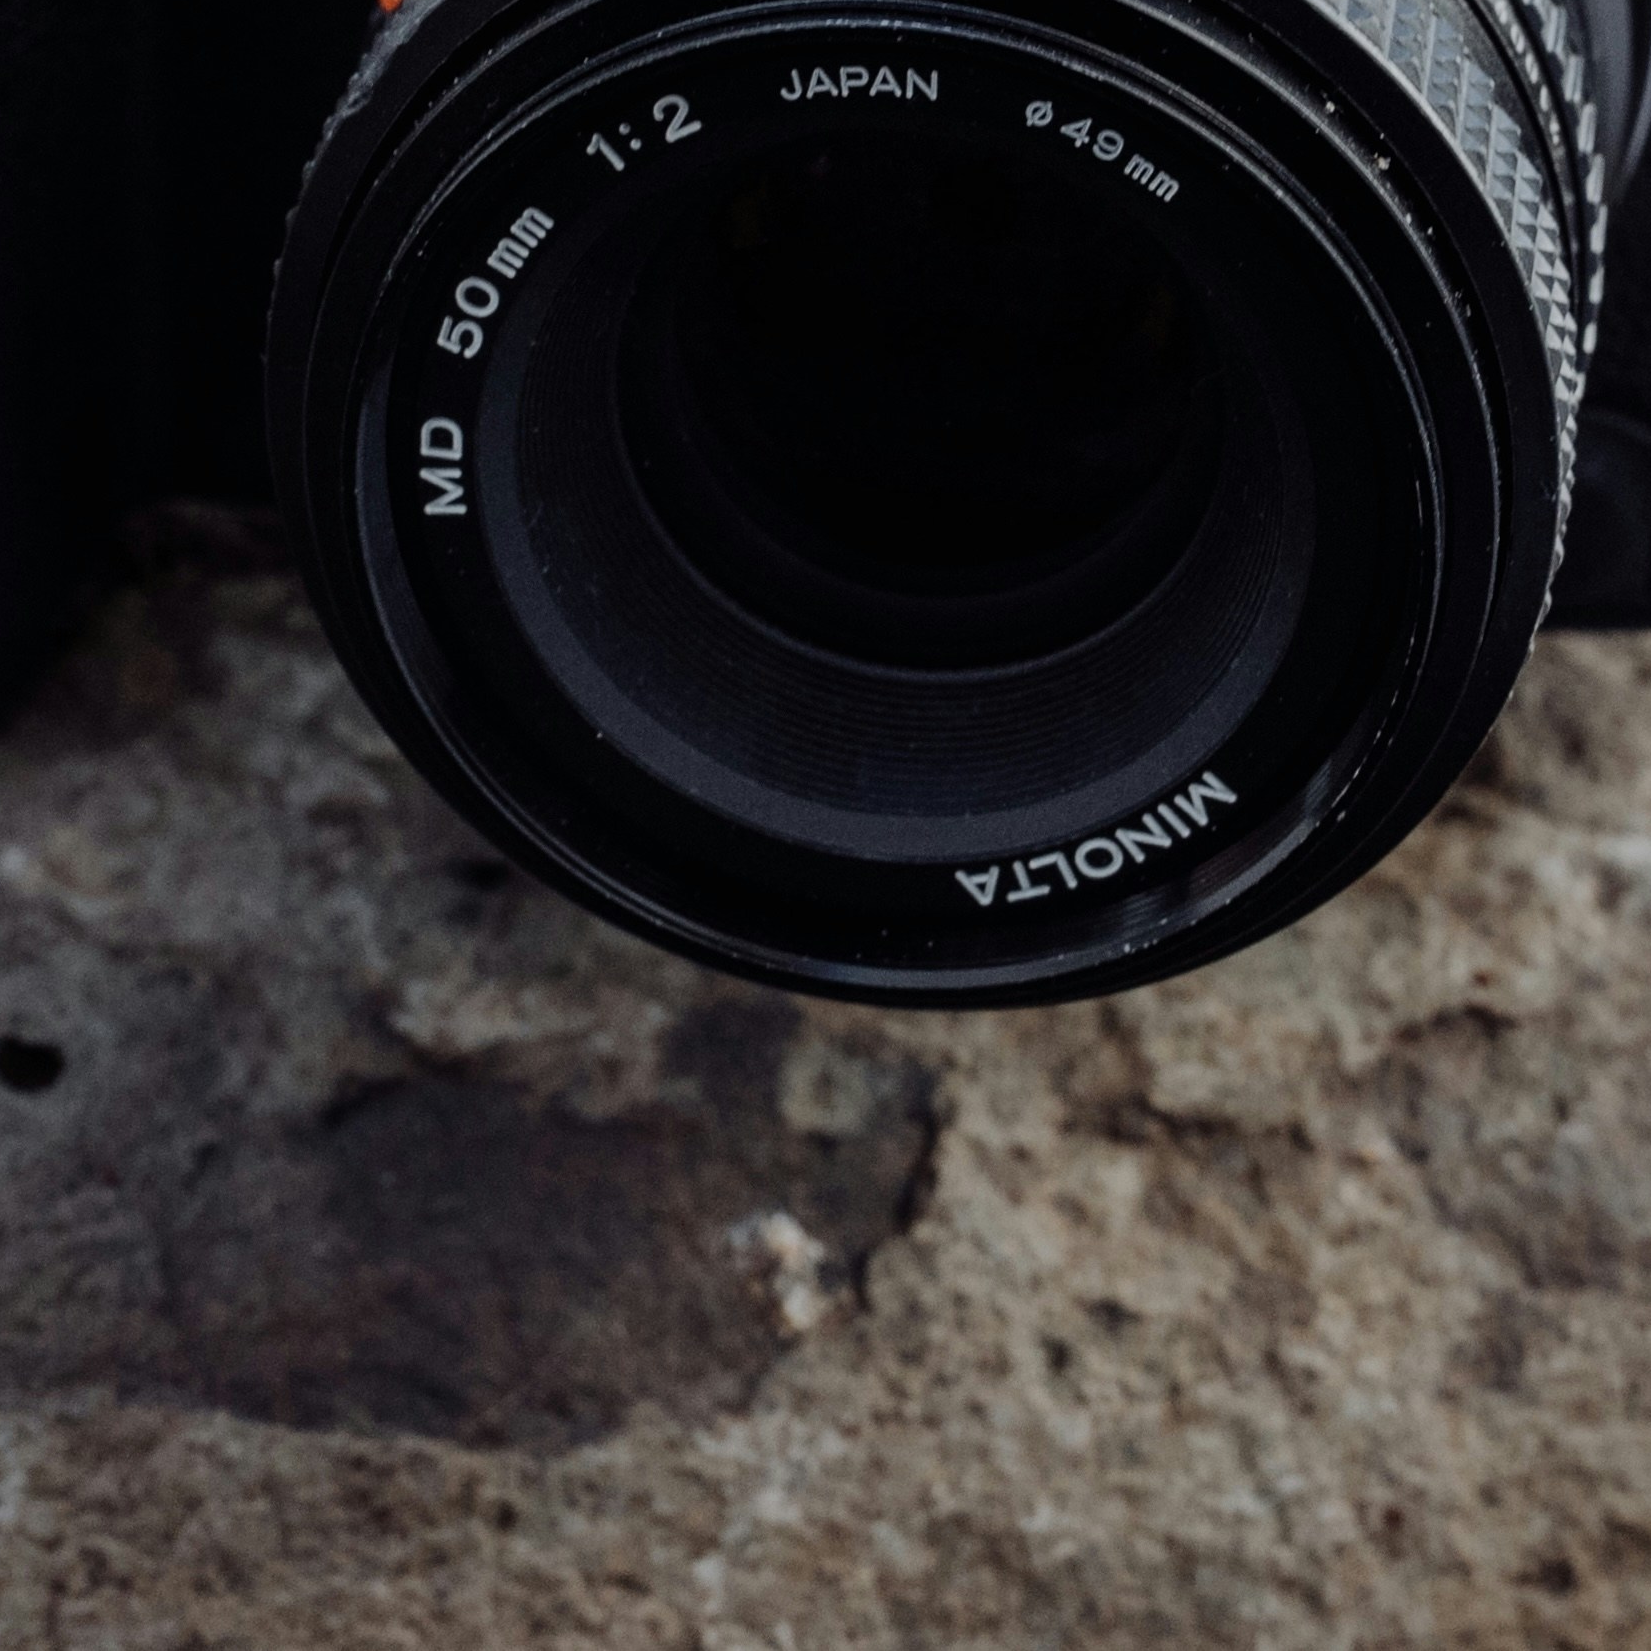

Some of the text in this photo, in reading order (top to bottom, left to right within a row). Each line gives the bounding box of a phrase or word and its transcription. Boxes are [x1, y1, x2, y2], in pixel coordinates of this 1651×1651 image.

[780, 66, 939, 102] JAPAN
[419, 417, 469, 516] MD
[585, 94, 702, 172] 1:2
[954, 771, 1238, 906] MINOLTA
